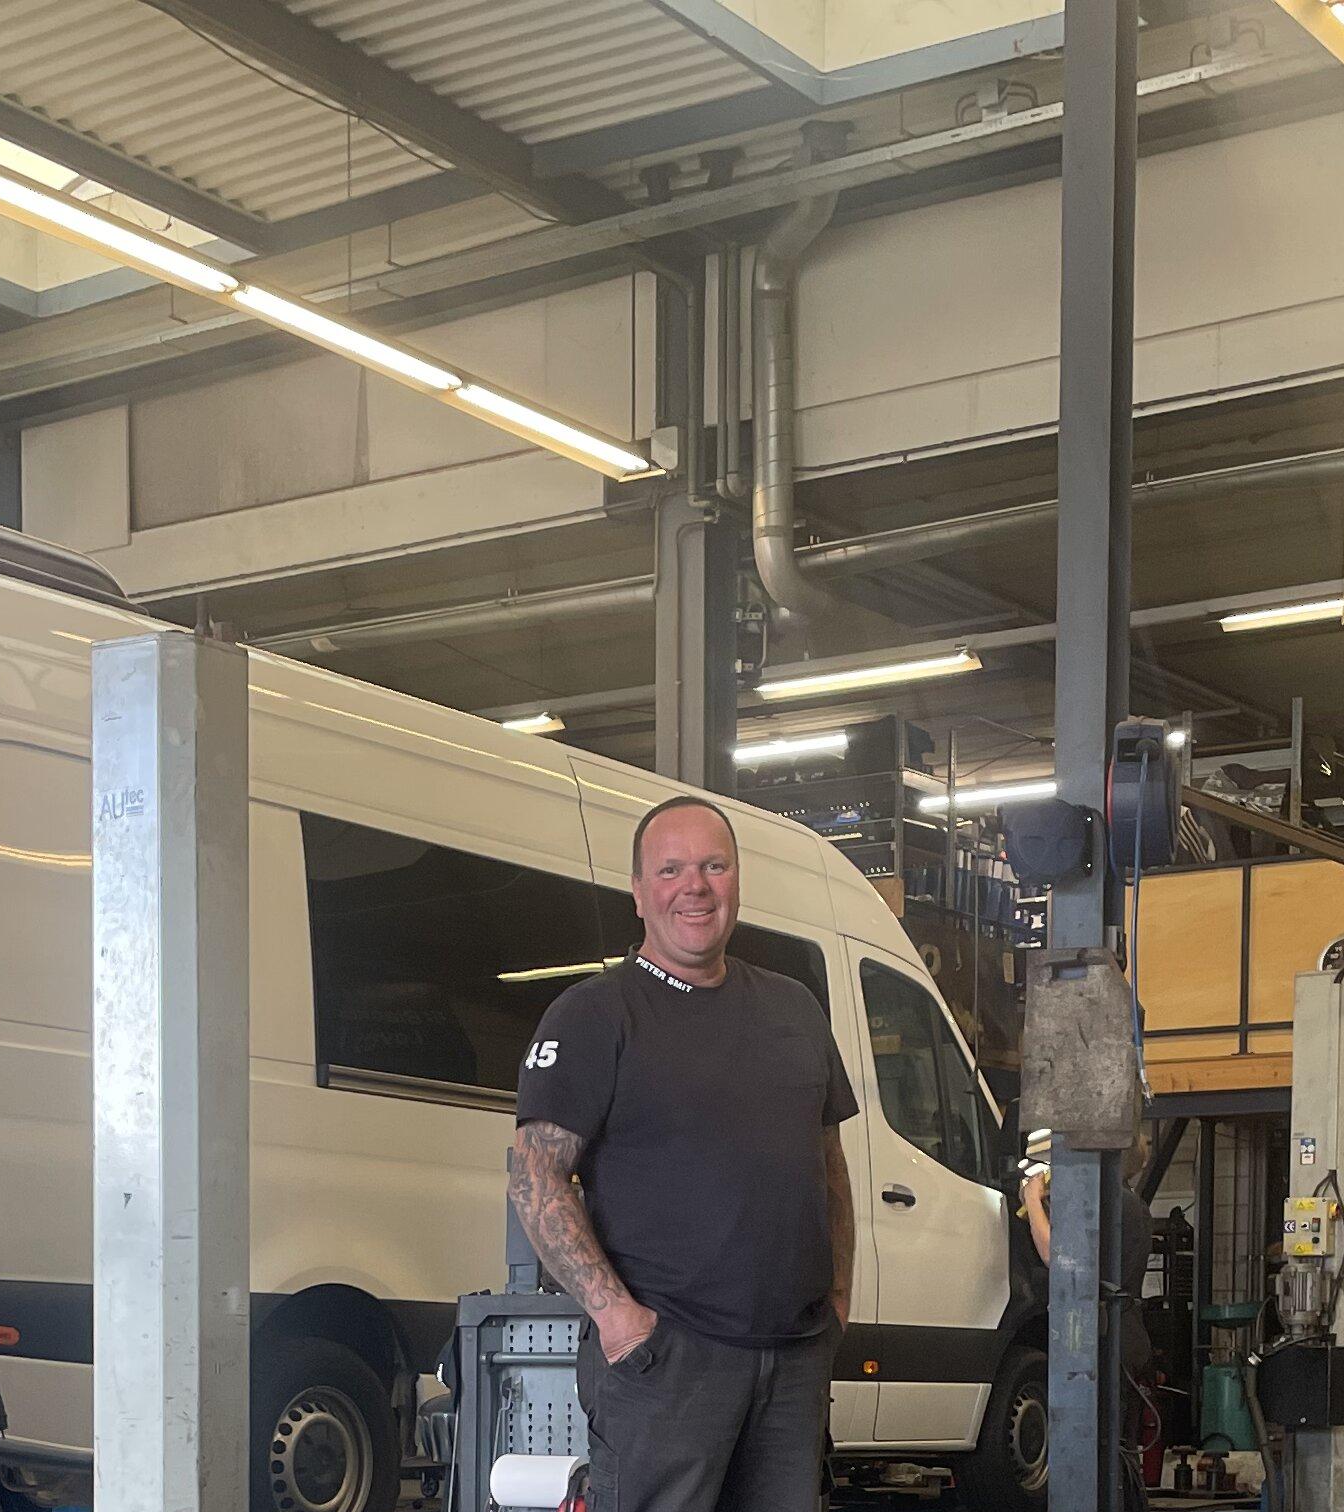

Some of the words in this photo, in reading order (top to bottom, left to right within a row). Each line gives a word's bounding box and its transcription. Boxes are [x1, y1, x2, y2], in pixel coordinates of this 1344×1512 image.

[635, 956, 667, 981] PIETER
[667, 976, 694, 994] SMIT
[525, 1040, 559, 1070] 45
